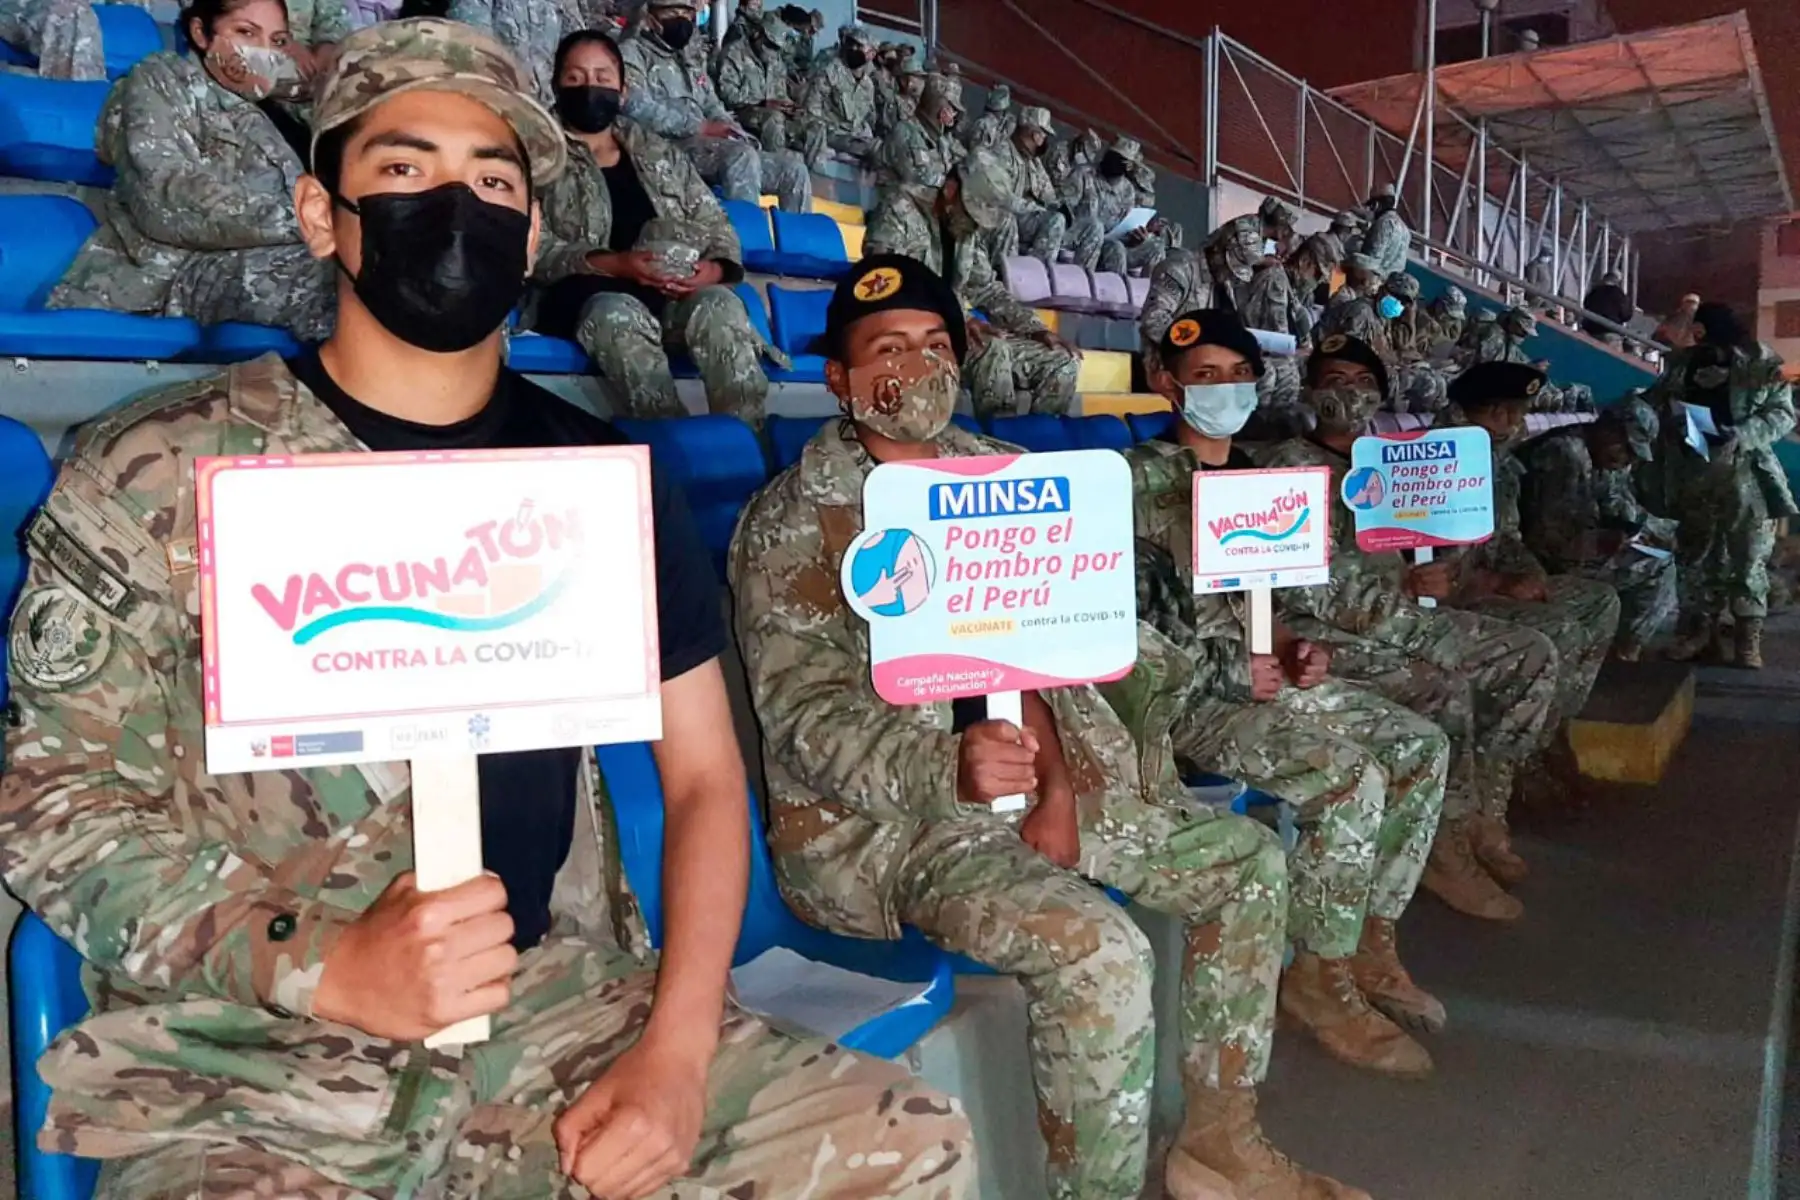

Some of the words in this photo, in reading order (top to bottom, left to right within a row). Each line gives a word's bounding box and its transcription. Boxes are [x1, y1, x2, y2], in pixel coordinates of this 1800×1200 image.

[1387, 442, 1452, 461] MINSA
[1391, 463, 1438, 478] Pongo
[1444, 460, 1458, 475] el
[938, 479, 1063, 516] MINSA
[1391, 478, 1453, 493] hombro
[1458, 477, 1485, 491] por
[1392, 494, 1405, 508] el
[1411, 491, 1446, 507] Perú
[1208, 487, 1309, 539] VACUNATÓN
[945, 525, 1036, 553] Pongo
[1046, 517, 1073, 543] el
[251, 499, 585, 631] VACUNATÓN
[945, 552, 1061, 582] hombro
[1070, 551, 1123, 580] por
[947, 587, 974, 613] el
[983, 581, 1050, 611] Perú
[1021, 614, 1057, 627] contra
[1060, 612, 1070, 624] la
[1073, 611, 1125, 624] COVID-19
[312, 648, 429, 674] CONTRA
[435, 646, 468, 666] LA
